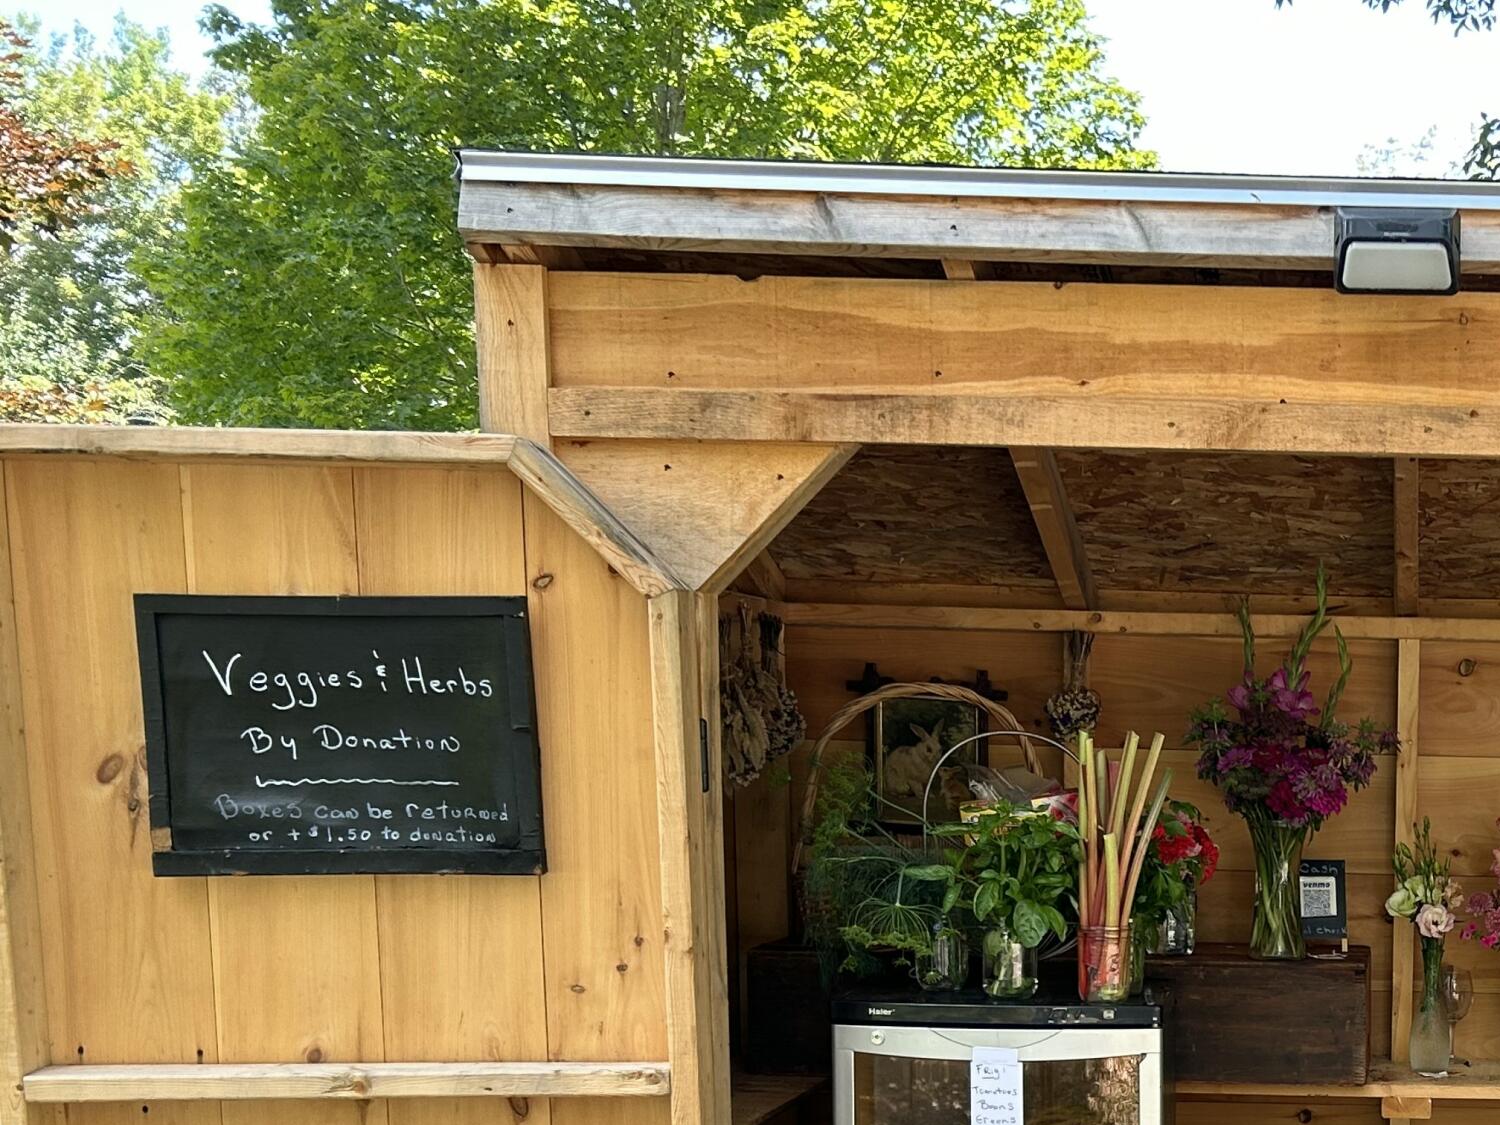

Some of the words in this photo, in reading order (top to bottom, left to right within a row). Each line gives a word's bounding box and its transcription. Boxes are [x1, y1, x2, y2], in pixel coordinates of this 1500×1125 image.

[202, 650, 363, 710] Veggies
[402, 656, 493, 697] Herbs
[240, 727, 298, 760] By
[313, 724, 461, 752] Donation
[213, 793, 303, 821] Boxes
[314, 805, 360, 820] can
[366, 802, 393, 820] be
[405, 800, 509, 822] returned
[249, 831, 273, 842] or
[381, 826, 400, 841] to
[410, 827, 496, 843] donation
[1299, 863, 1338, 874] Cash
